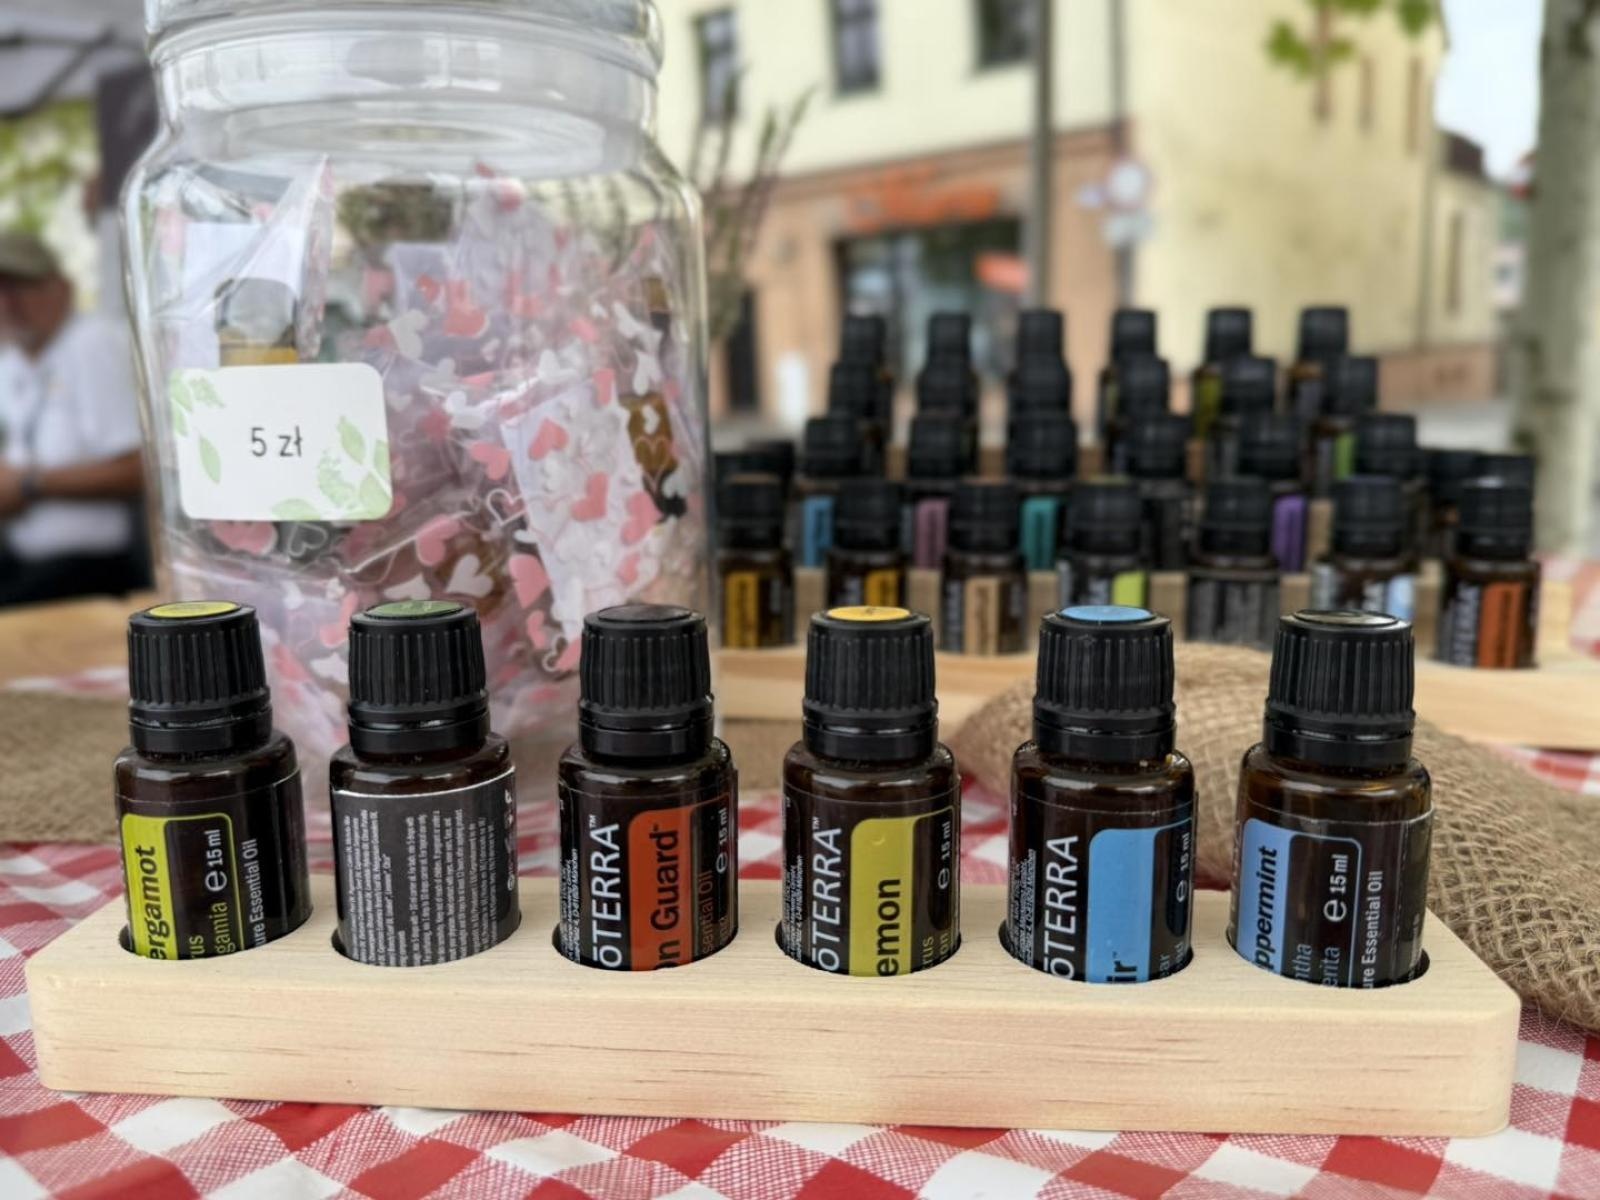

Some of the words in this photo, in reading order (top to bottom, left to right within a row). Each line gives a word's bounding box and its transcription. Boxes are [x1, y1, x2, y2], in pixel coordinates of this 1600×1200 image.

[250, 427, 268, 458] 5
[277, 425, 303, 458] zł
[718, 807, 728, 825] ml
[205, 829, 222, 847] ml
[719, 829, 729, 847] 15
[941, 821, 951, 838] ml
[206, 848, 224, 867] 15
[241, 838, 258, 860] Oil
[940, 841, 951, 861] 15
[1180, 853, 1190, 871] 15
[1331, 854, 1349, 873] ml
[1329, 875, 1347, 894] 15
[1368, 870, 1384, 891] Oil
[243, 862, 266, 922] Essential
[876, 878, 901, 976] emon
[1362, 895, 1382, 964] Essential
